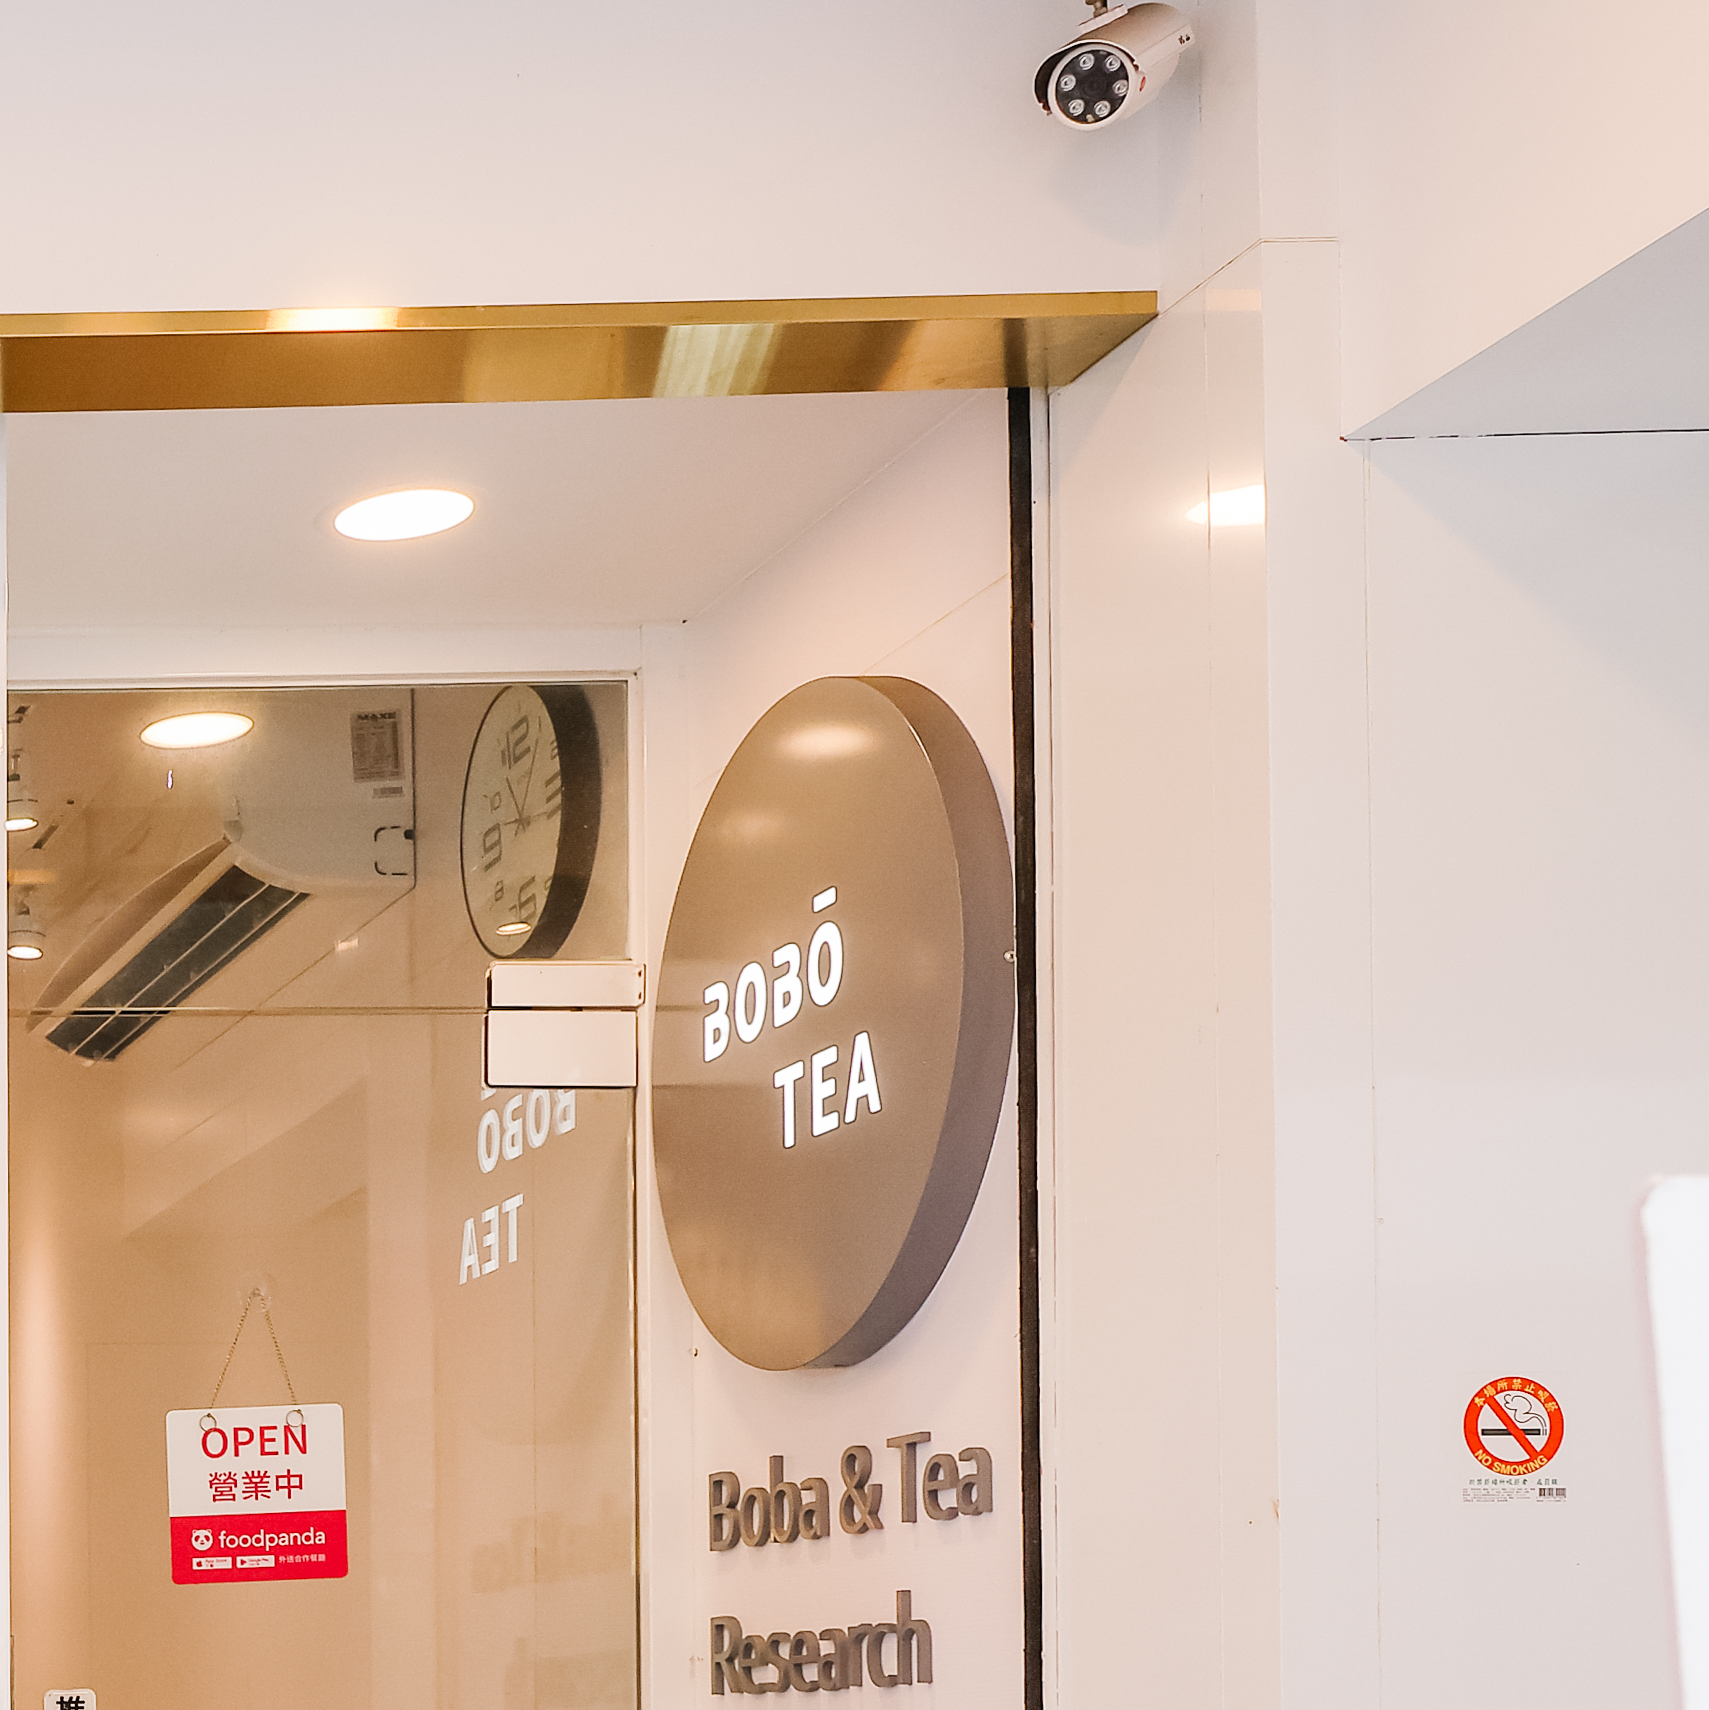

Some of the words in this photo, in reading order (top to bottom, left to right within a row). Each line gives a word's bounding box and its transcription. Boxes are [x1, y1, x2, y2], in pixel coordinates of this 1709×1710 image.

[772, 1030, 883, 1150] TEA
[200, 1423, 309, 1459] OPEN
[1474, 1449, 1492, 1467] NO
[1492, 1455, 1548, 1475] SMOKING
[208, 1468, 305, 1503] 營業中
[708, 1453, 831, 1553] Boba
[839, 1445, 883, 1535] &
[886, 1430, 994, 1524] Tea
[218, 1526, 326, 1552] foodpanda
[709, 1589, 933, 1696] Research
